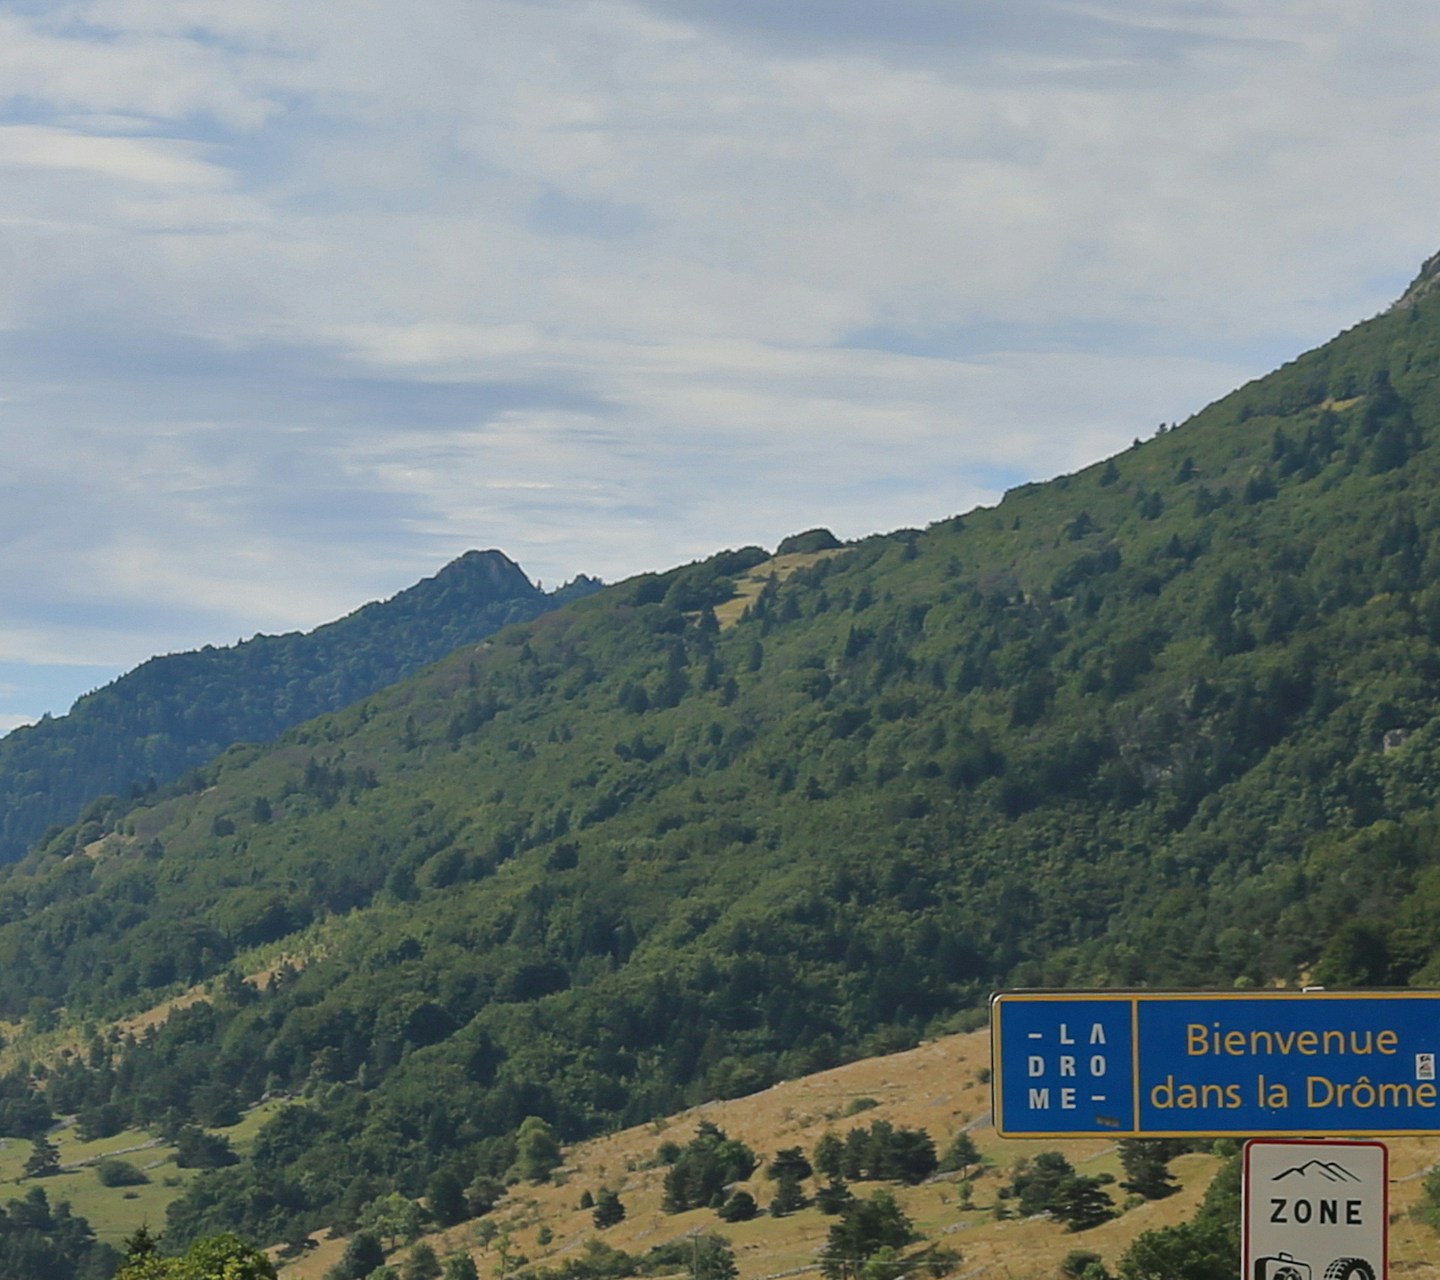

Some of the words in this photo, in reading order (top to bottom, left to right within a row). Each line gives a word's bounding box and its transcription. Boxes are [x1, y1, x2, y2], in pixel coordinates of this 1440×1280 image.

[1187, 1022, 1398, 1056] Bienvenue
[1151, 1075, 1241, 1109] dans
[1258, 1074, 1288, 1108] la
[1306, 1076, 1437, 1108] Drôme
[1270, 1199, 1362, 1225] ZONE
